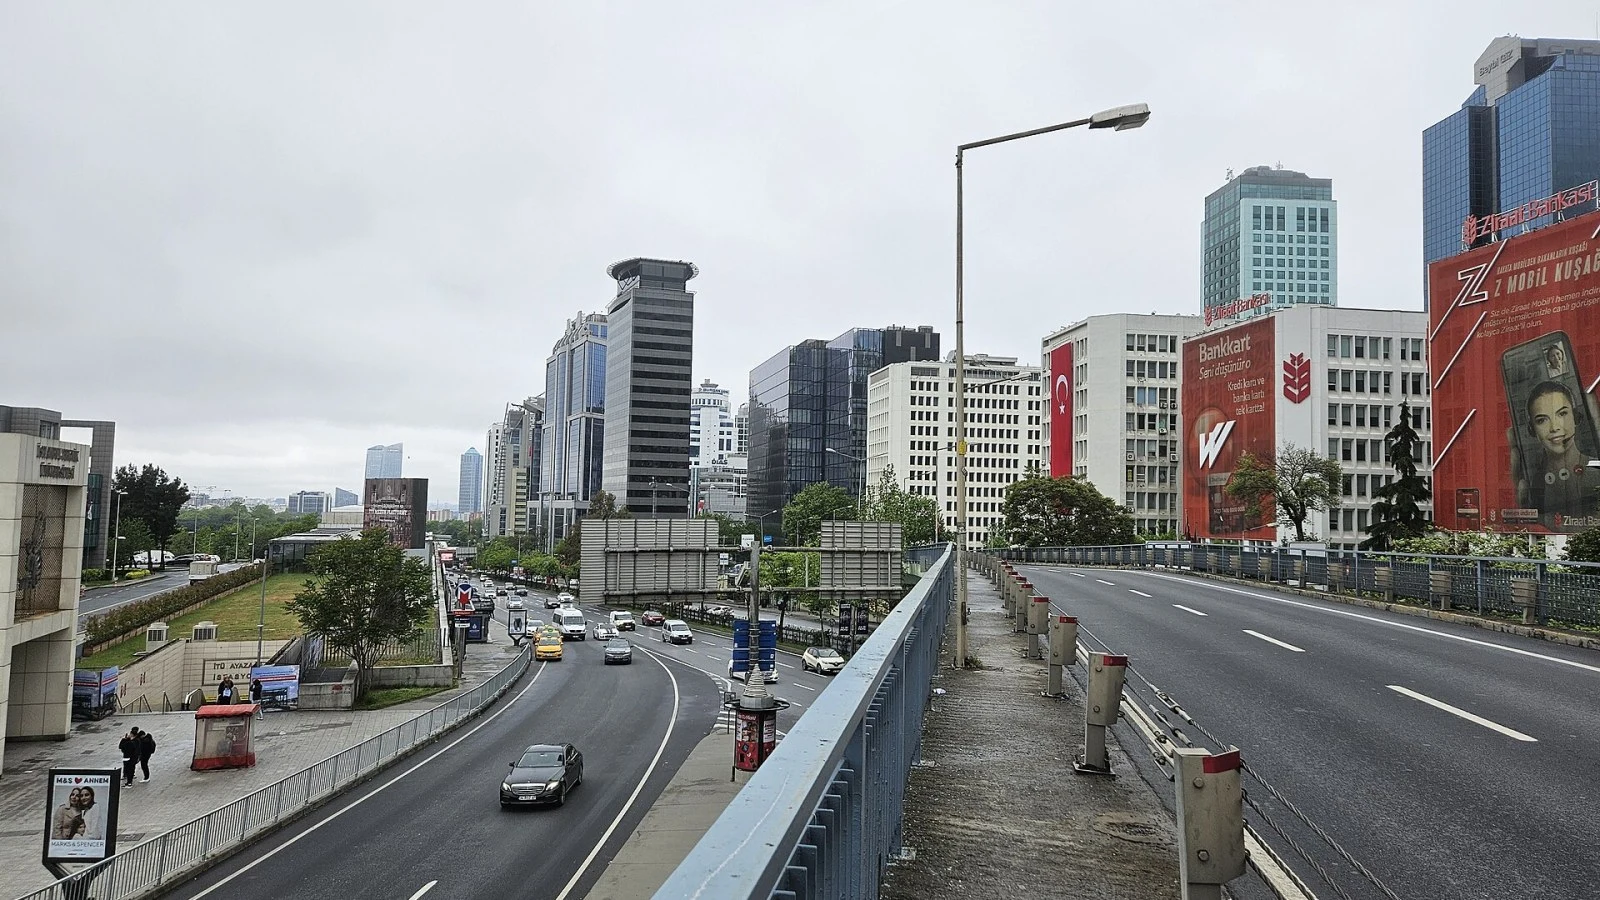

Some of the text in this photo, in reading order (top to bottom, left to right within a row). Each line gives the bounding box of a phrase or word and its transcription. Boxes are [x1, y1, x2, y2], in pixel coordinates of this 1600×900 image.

[1481, 184, 1592, 235] Ziraat Bankası
[1494, 279, 1502, 297] Z
[1507, 267, 1547, 294] MOBİL
[1511, 303, 1530, 312] Ziraat
[1555, 291, 1581, 303] hemen
[1199, 333, 1251, 363] Bankkart
[1199, 364, 1215, 379] Seni
[1227, 379, 1243, 391] Kredi
[1563, 515, 1587, 526] Ziraat
